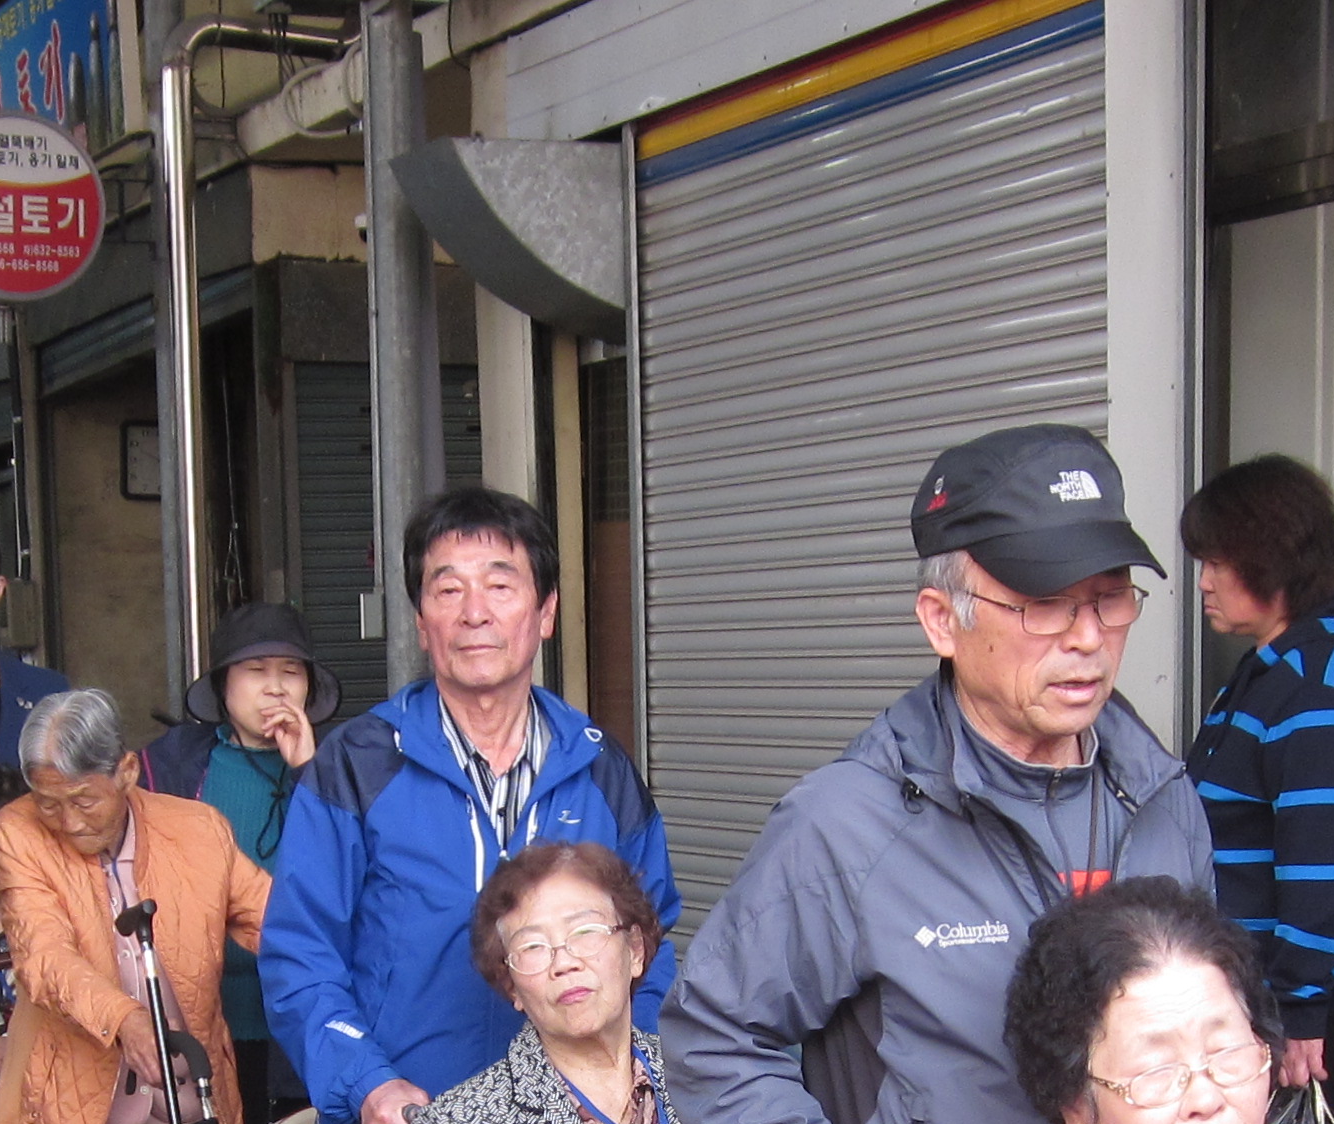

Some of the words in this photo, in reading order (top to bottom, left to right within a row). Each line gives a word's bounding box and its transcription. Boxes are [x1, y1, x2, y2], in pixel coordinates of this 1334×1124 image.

[29, 153, 52, 168] 옹기
[1058, 470, 1080, 482] THE
[1049, 481, 1082, 494] NORTH
[1059, 490, 1084, 503] FACE
[935, 920, 1010, 940] Columbia
